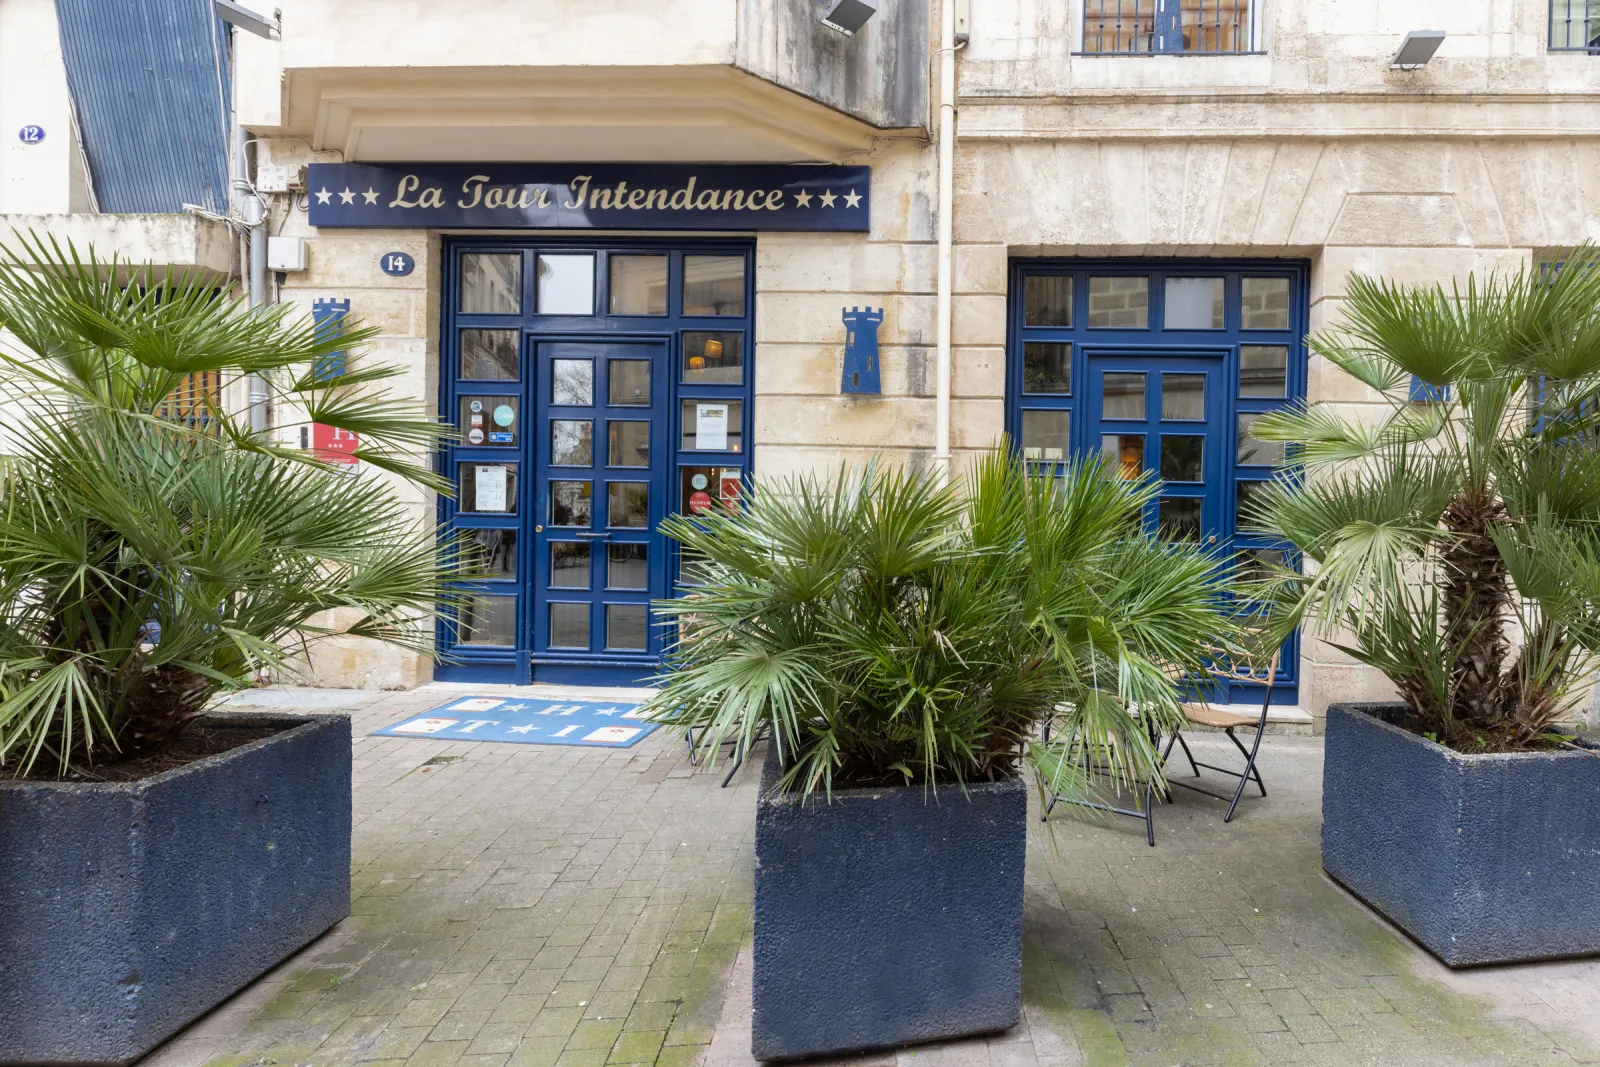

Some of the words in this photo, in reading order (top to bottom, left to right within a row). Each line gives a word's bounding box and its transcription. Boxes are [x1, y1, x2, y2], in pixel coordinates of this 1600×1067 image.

[24, 127, 39, 141] 12
[389, 174, 445, 209] La
[457, 175, 553, 210] Tour
[562, 174, 784, 211] Intendance
[388, 255, 405, 271] 14
